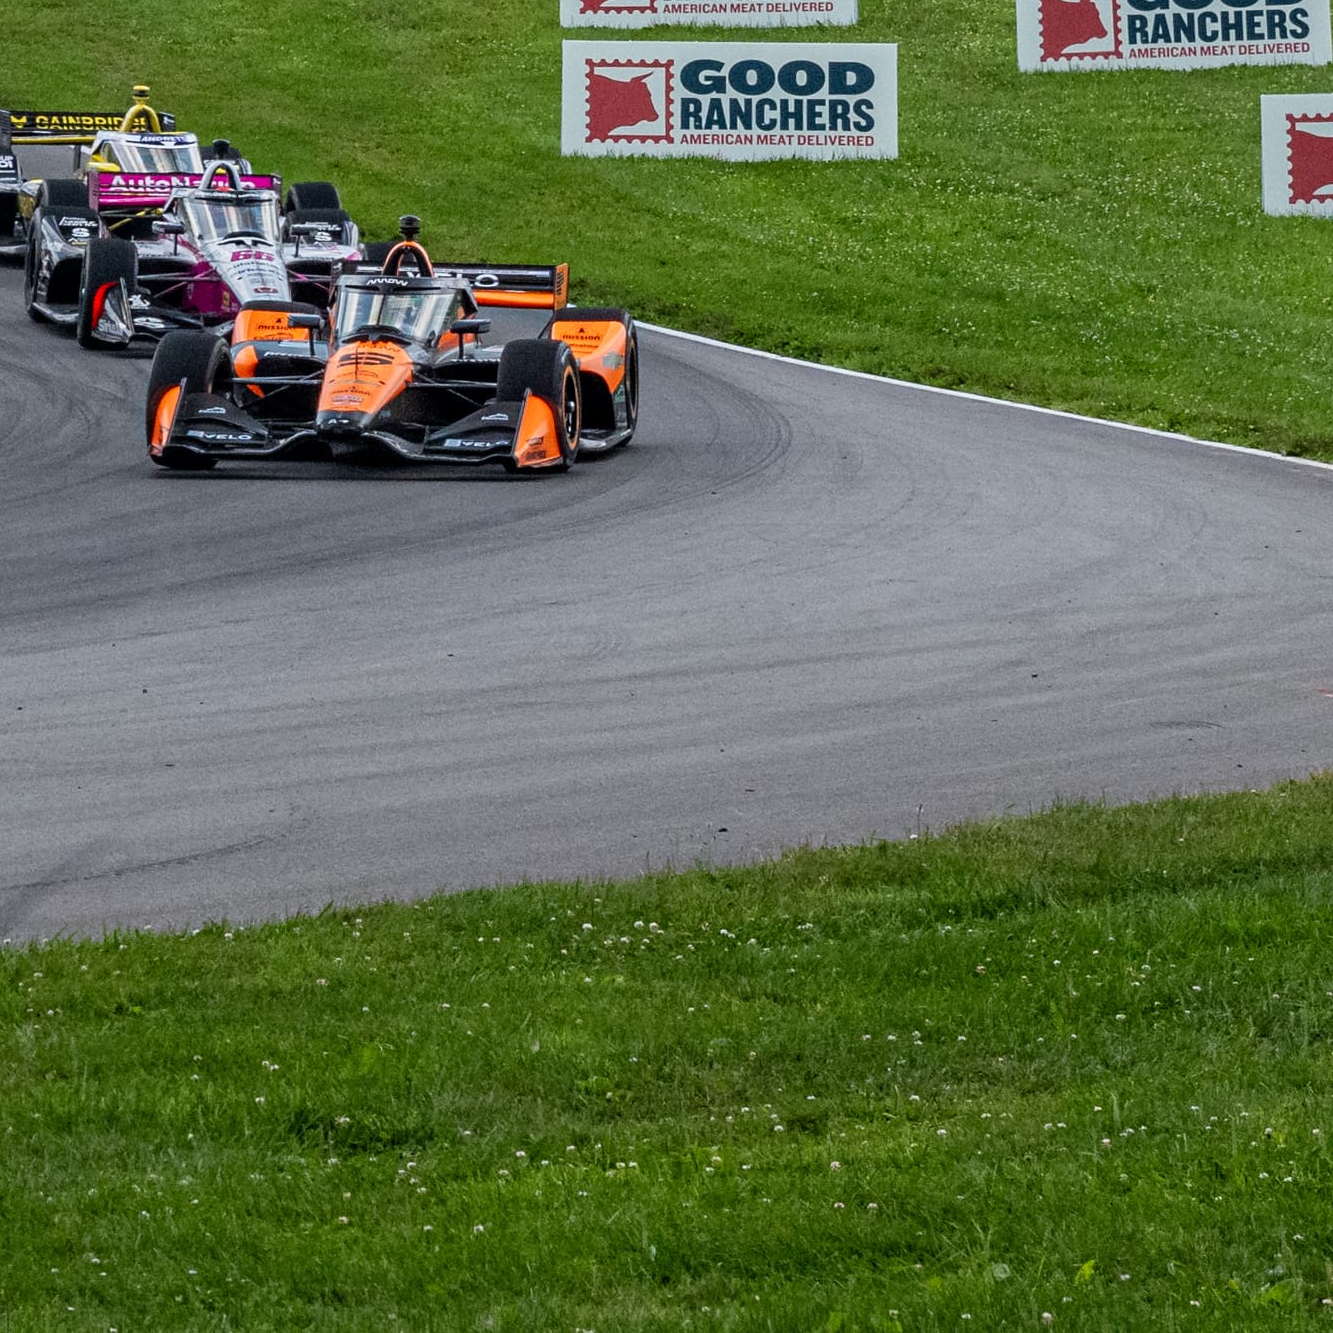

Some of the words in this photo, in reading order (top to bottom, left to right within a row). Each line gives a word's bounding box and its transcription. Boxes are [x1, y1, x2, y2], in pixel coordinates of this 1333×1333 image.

[663, 3, 727, 14] AMERICAN
[730, 3, 764, 14] MEAT
[766, 2, 833, 13] DELIVERED
[1127, 7, 1310, 45] RANCHERS
[1128, 46, 1197, 59] AMERICAN
[1200, 45, 1236, 57] MEAT
[1238, 42, 1310, 55] DELIVERED
[680, 59, 875, 96] GOOD
[680, 97, 874, 132] RANCHERS
[680, 134, 753, 146] AMERICAN
[756, 134, 794, 146] MEAT
[797, 135, 875, 147] DELIVERED
[230, 250, 274, 262] 66
[562, 333, 601, 341] mission
